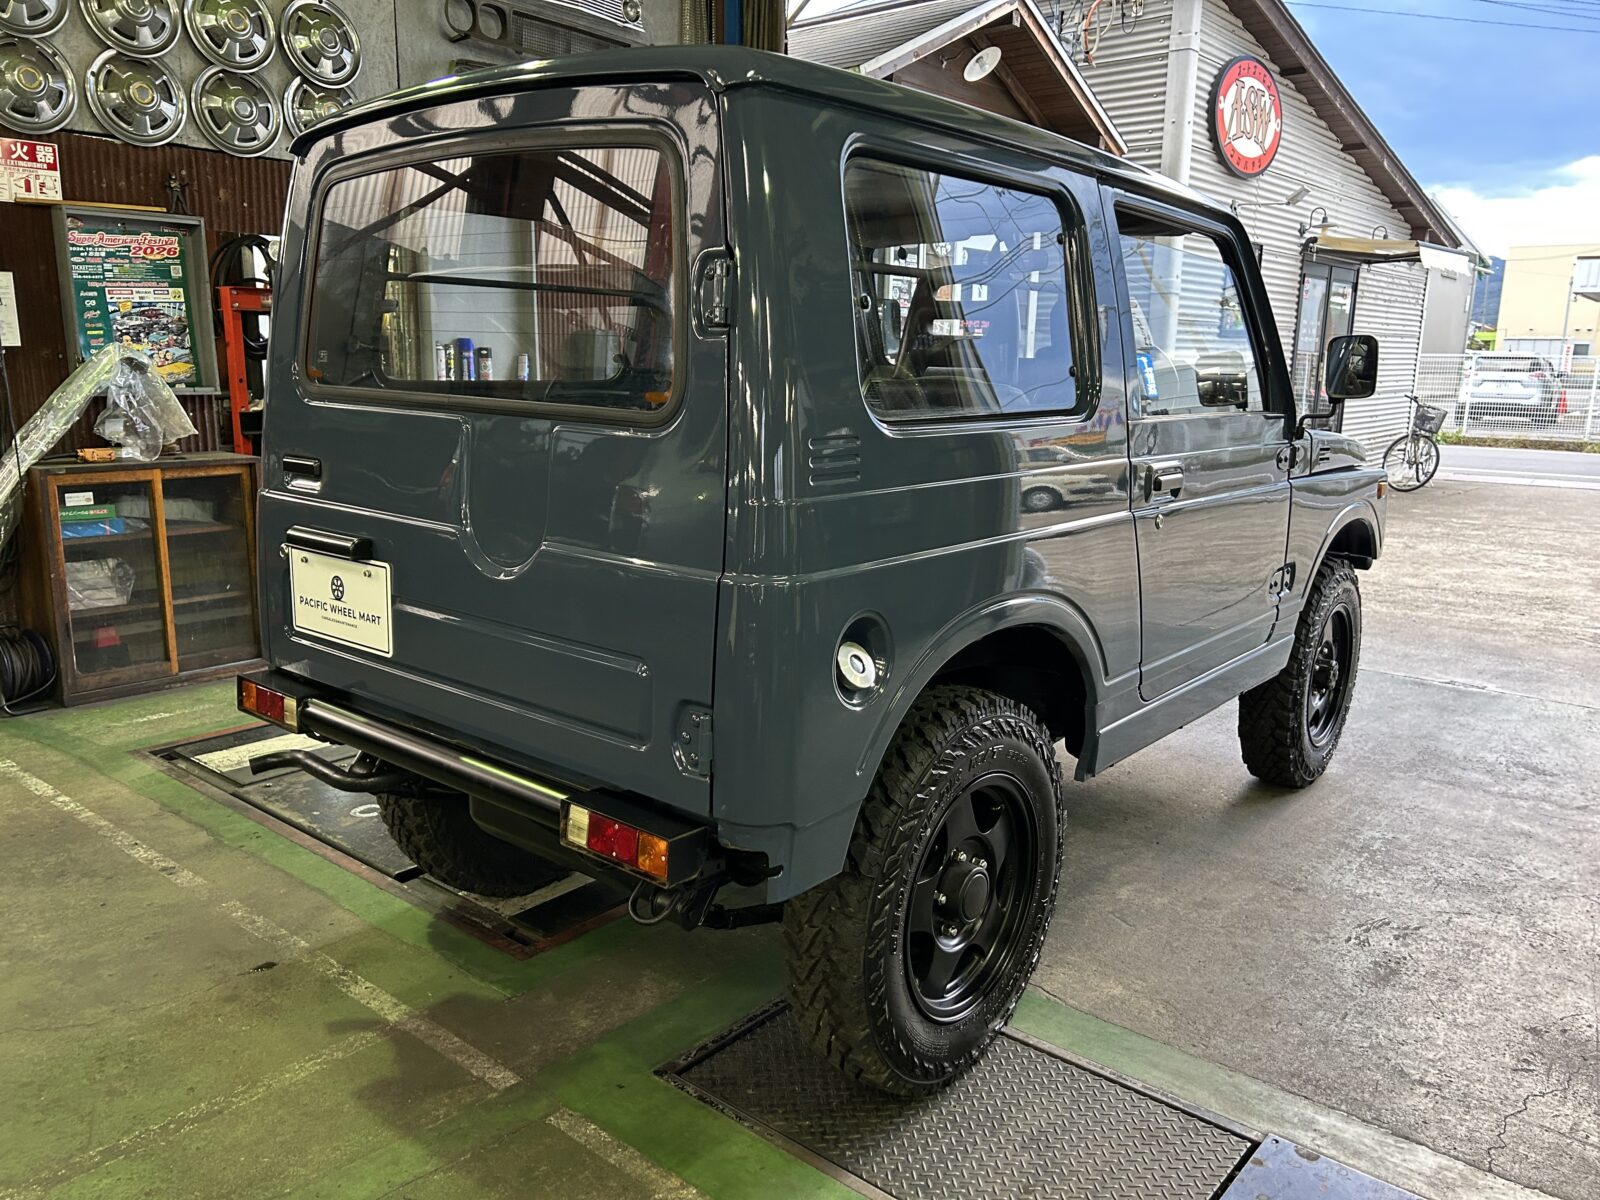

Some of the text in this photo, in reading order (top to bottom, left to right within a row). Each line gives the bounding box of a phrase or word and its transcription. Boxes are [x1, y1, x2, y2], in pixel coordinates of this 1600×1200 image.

[0, 142, 55, 164] 火器
[130, 246, 179, 257] 2026
[299, 595, 382, 626] PACIFIC WHEEL MART
